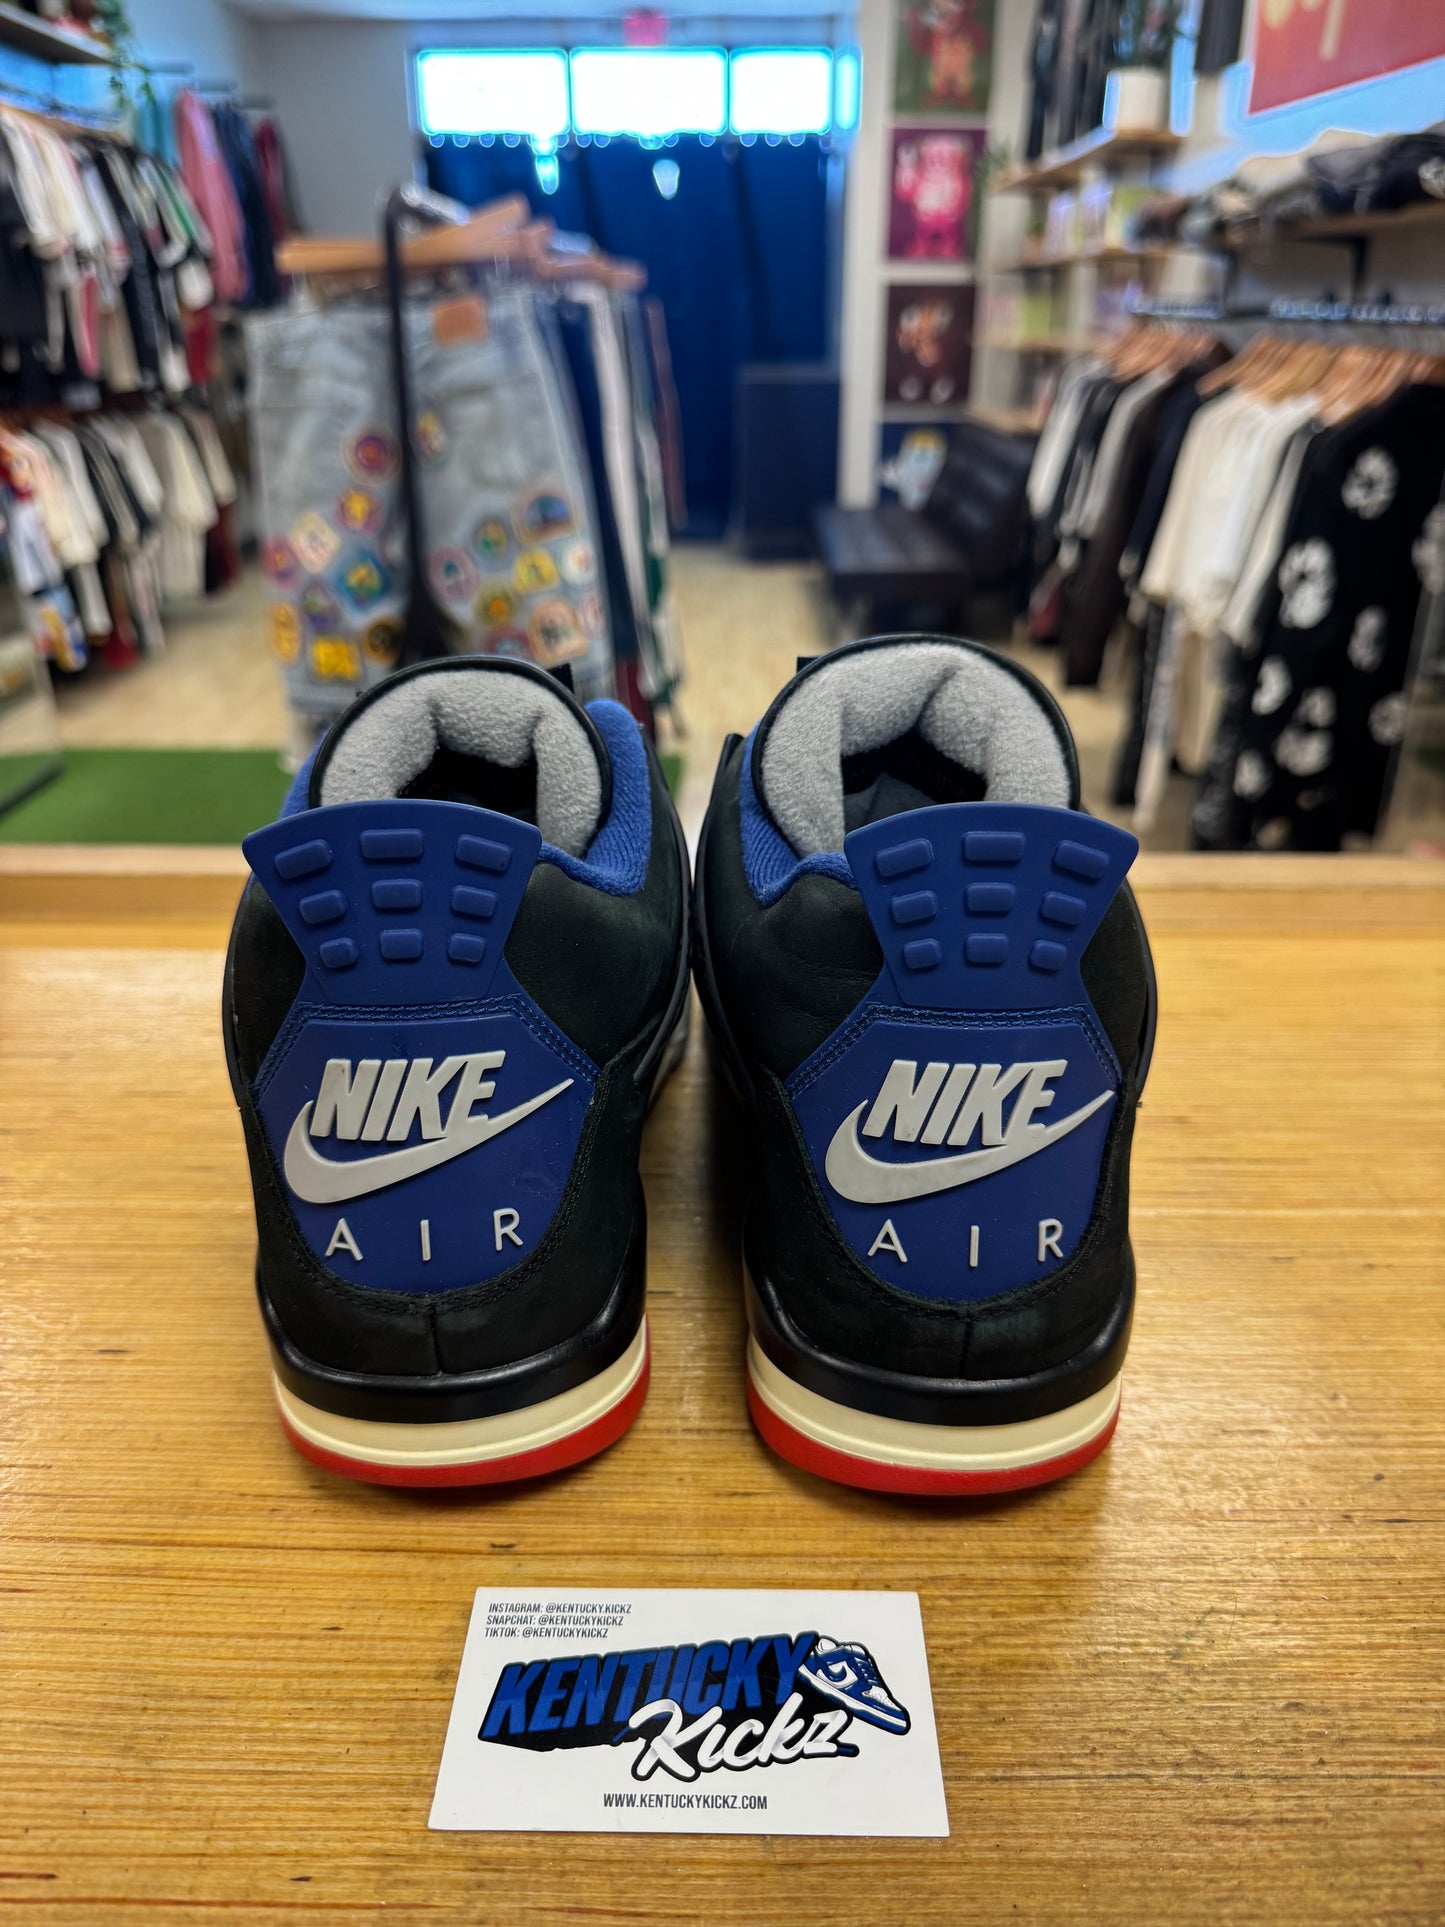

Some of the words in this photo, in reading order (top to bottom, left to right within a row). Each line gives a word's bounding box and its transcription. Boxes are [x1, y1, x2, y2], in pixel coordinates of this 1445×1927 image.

[310, 1050, 506, 1141] NIKE
[861, 1059, 1068, 1146] NIKE
[325, 1208, 524, 1262] AIR
[867, 1218, 1064, 1267] AIR
[484, 1626, 520, 1638] TIKTOK:
[522, 1626, 609, 1639] @KENTUCKYKICKZ
[486, 1614, 536, 1625] SNAPCHAT:
[538, 1614, 624, 1626] @KENTUCKYKICKZ
[488, 1602, 544, 1614] INSTAGRAM:
[545, 1602, 632, 1614] @KENTUCKY.KICKZ
[480, 1632, 820, 1740] KENTUCKY
[630, 1692, 856, 1778] Kickz
[603, 1793, 768, 1810] WWW.KENTUCKYKICKZ.COM
